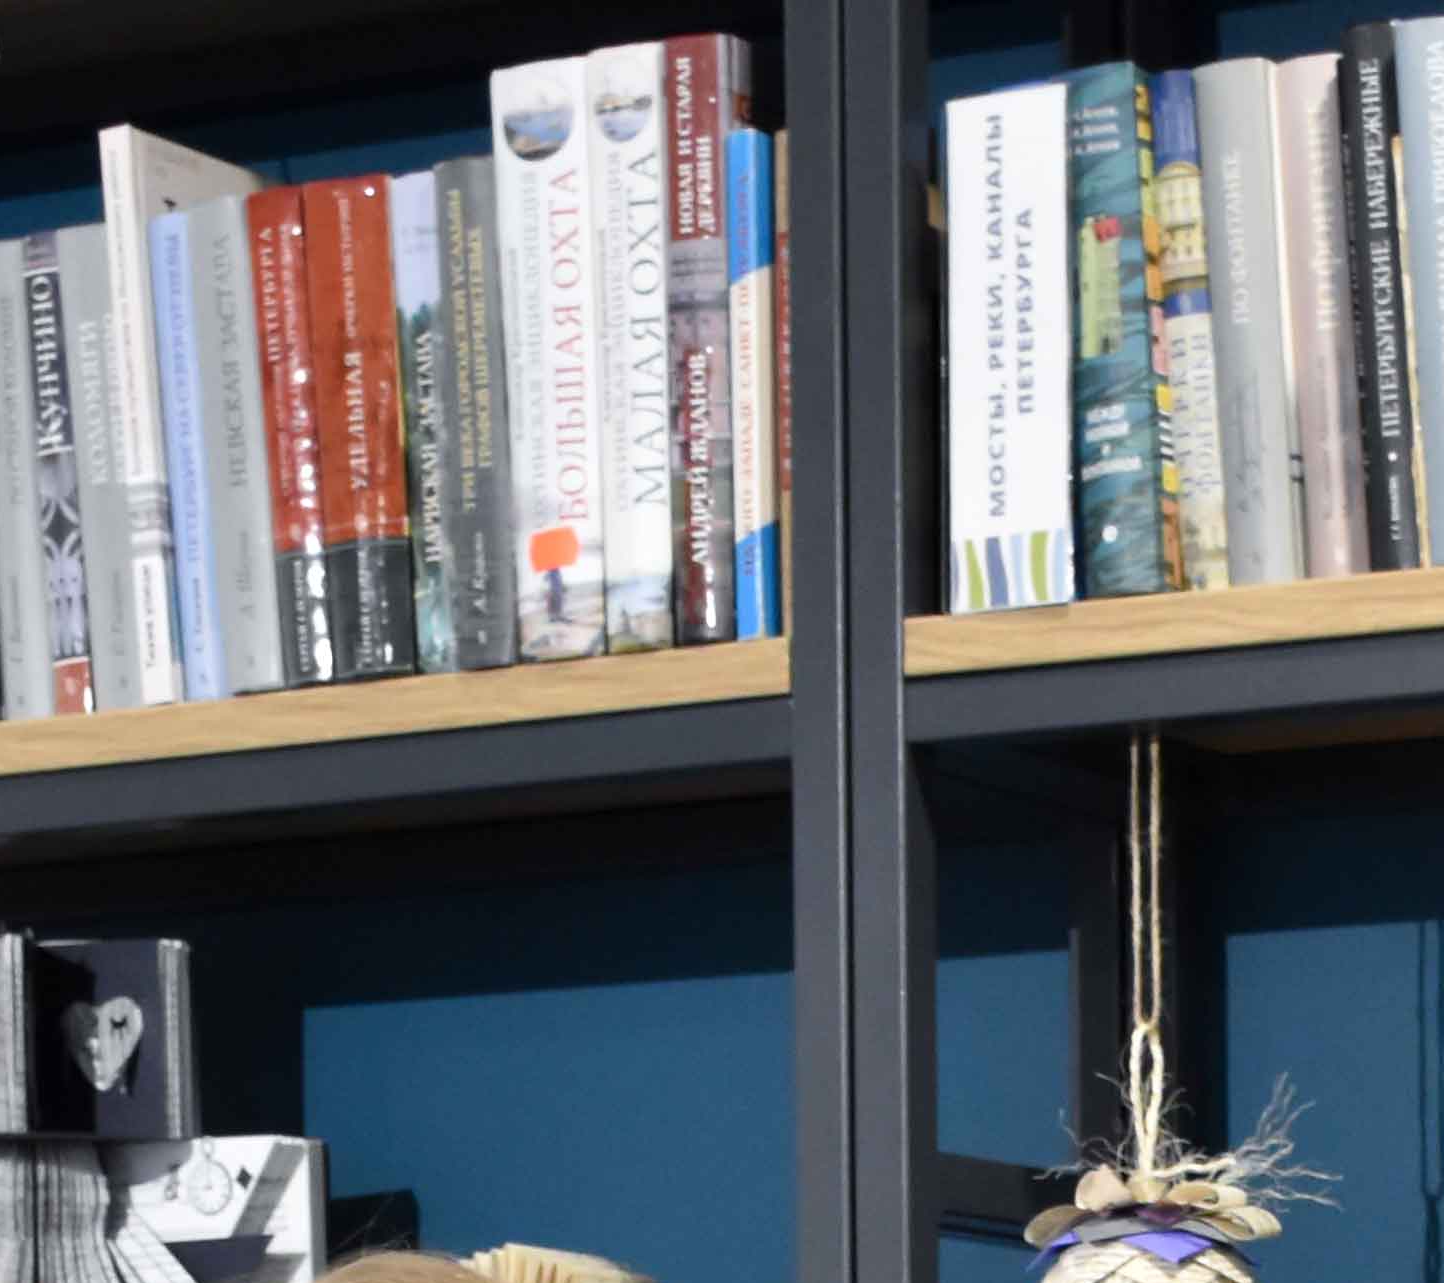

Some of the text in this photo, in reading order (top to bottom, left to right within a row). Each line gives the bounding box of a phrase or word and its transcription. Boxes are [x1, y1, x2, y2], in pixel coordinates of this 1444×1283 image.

[212, 234, 247, 487] НЕВСКАЯ ЗАСТАВА
[548, 167, 590, 521] БОЛЬШАЯ ОХТА
[627, 150, 668, 508] МАЛАЯ ОХТА
[985, 114, 1008, 517] МОСТЫ, РЕКИ, КАНАЛЫ
[1015, 210, 1035, 414] ПЕТЕРБУРГА
[1359, 58, 1401, 437] ПЕТЕРБУРГСКИЕ НАБЕРЕЖНЫЕ
[688, 352, 710, 565] АНДРЕЙ ЖДАНОВ
